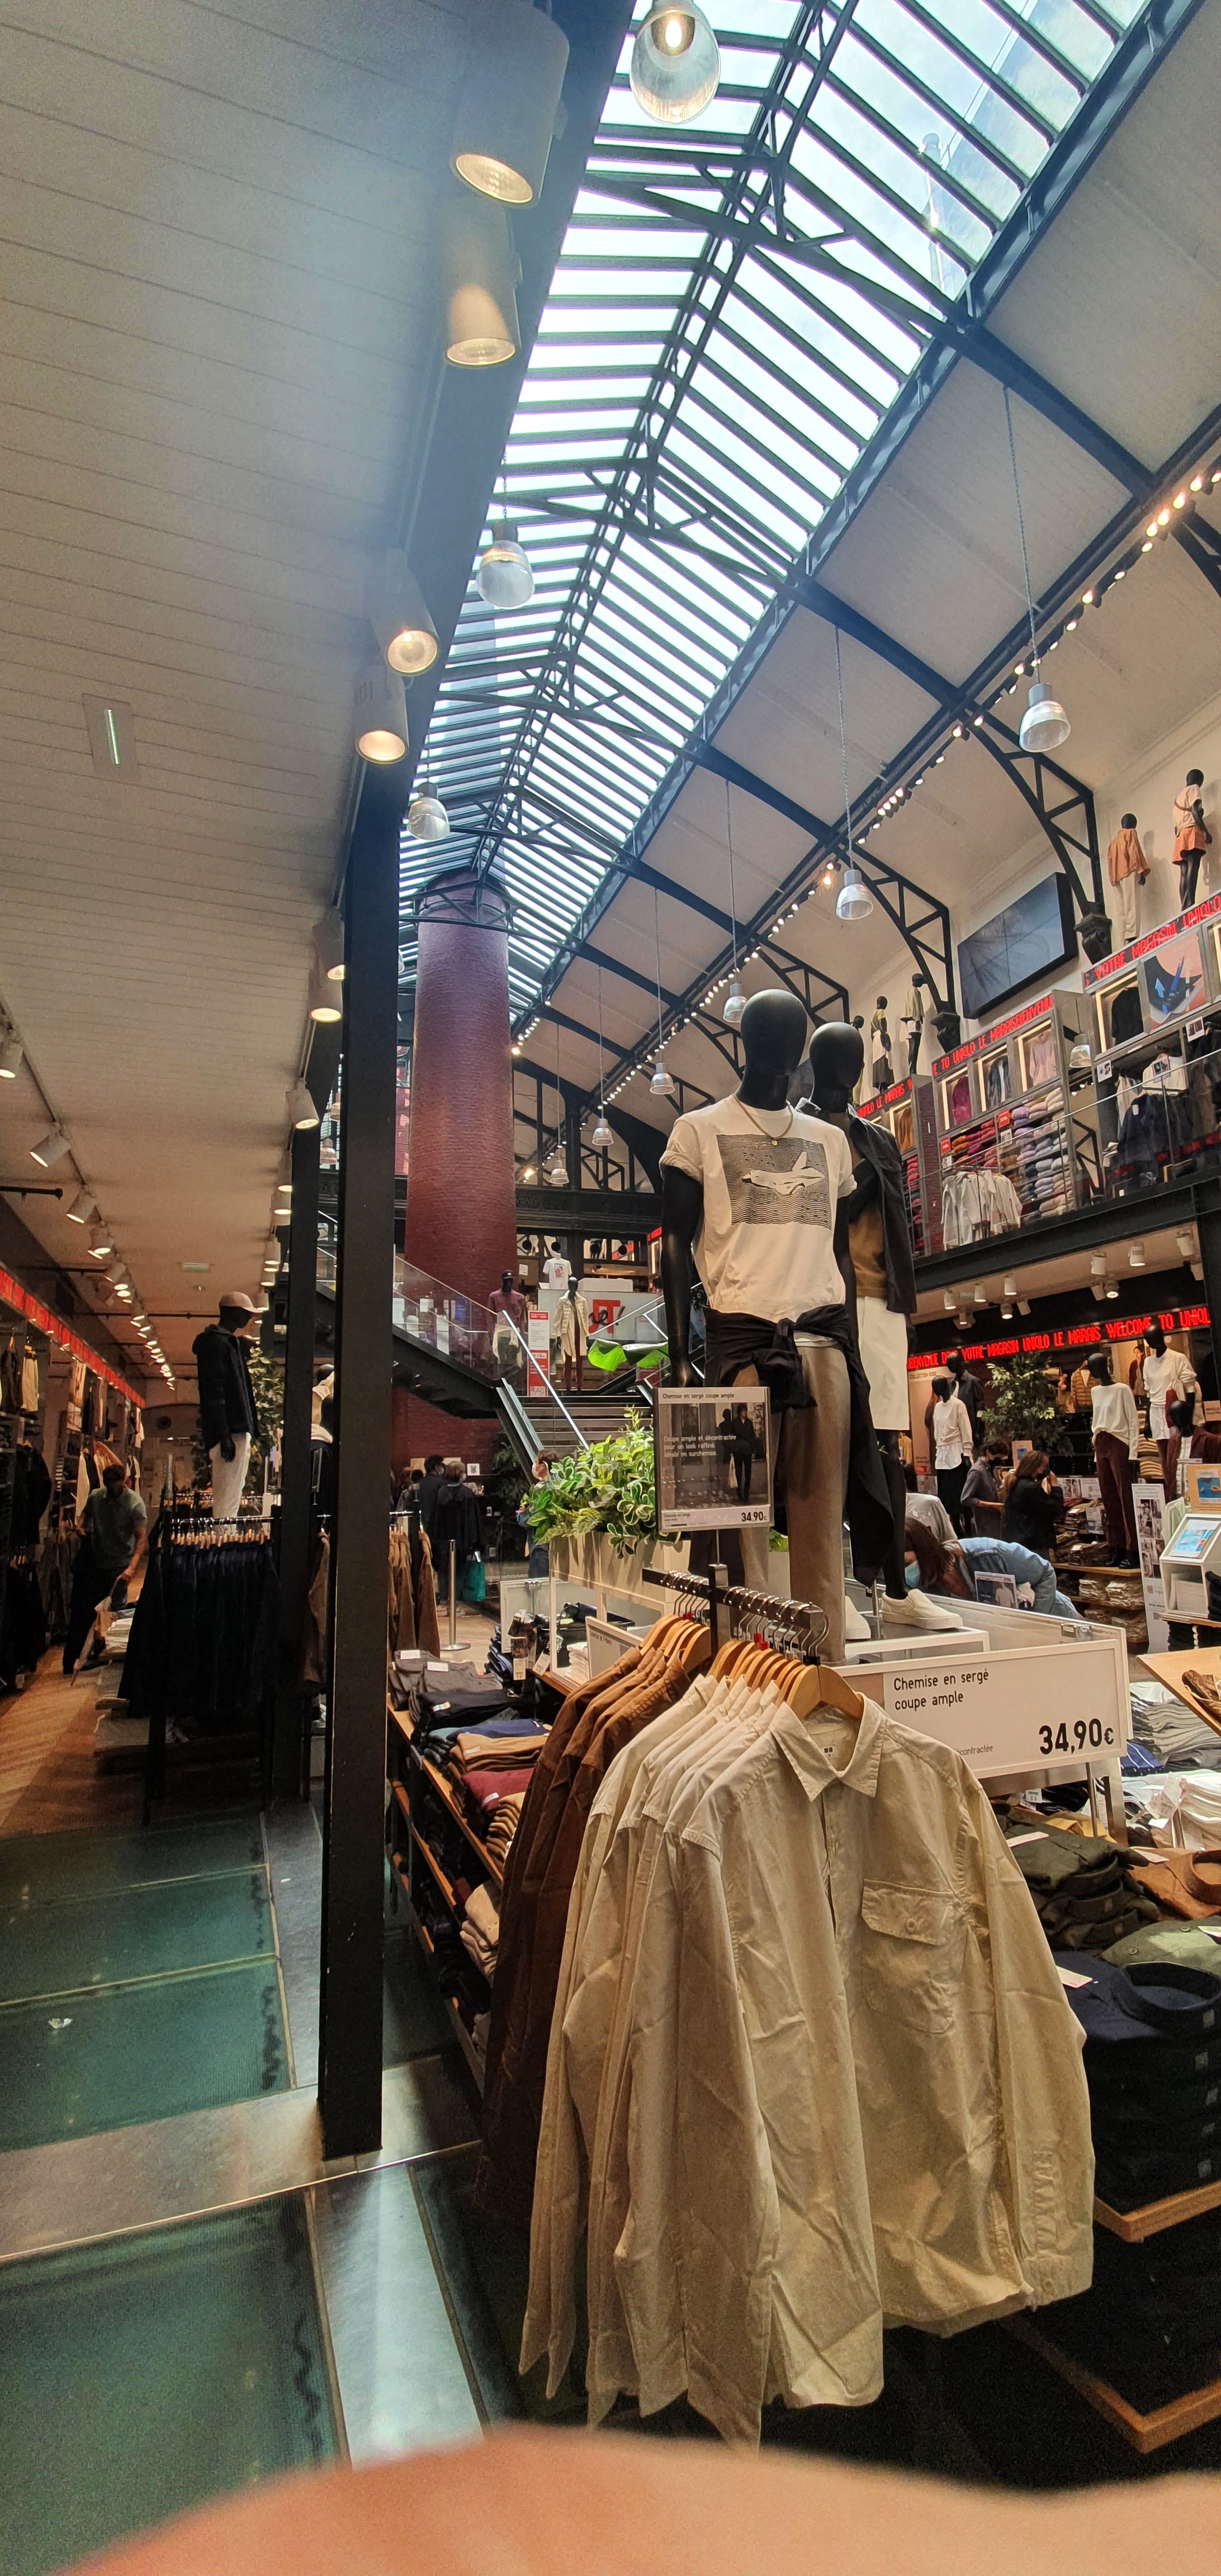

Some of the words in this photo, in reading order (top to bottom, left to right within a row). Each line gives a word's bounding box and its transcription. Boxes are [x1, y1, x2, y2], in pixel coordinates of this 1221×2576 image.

[940, 1057, 949, 1070] TO
[978, 1035, 986, 1049] LE
[962, 1346, 984, 1361] VOTRE
[987, 1339, 1019, 1357] MAGASIN
[1023, 1334, 1049, 1351] UNIQLO
[1053, 1332, 1064, 1347] LE
[1068, 1326, 1101, 1344] MARAIS
[1158, 1314, 1174, 1330] TO
[893, 1674, 939, 1691] Chemise
[944, 1675, 956, 1685] en
[960, 1668, 989, 1684] sergé
[895, 1696, 927, 1712] coupe
[932, 1690, 964, 1707] ample
[1038, 1718, 1114, 1755] 34,90€
